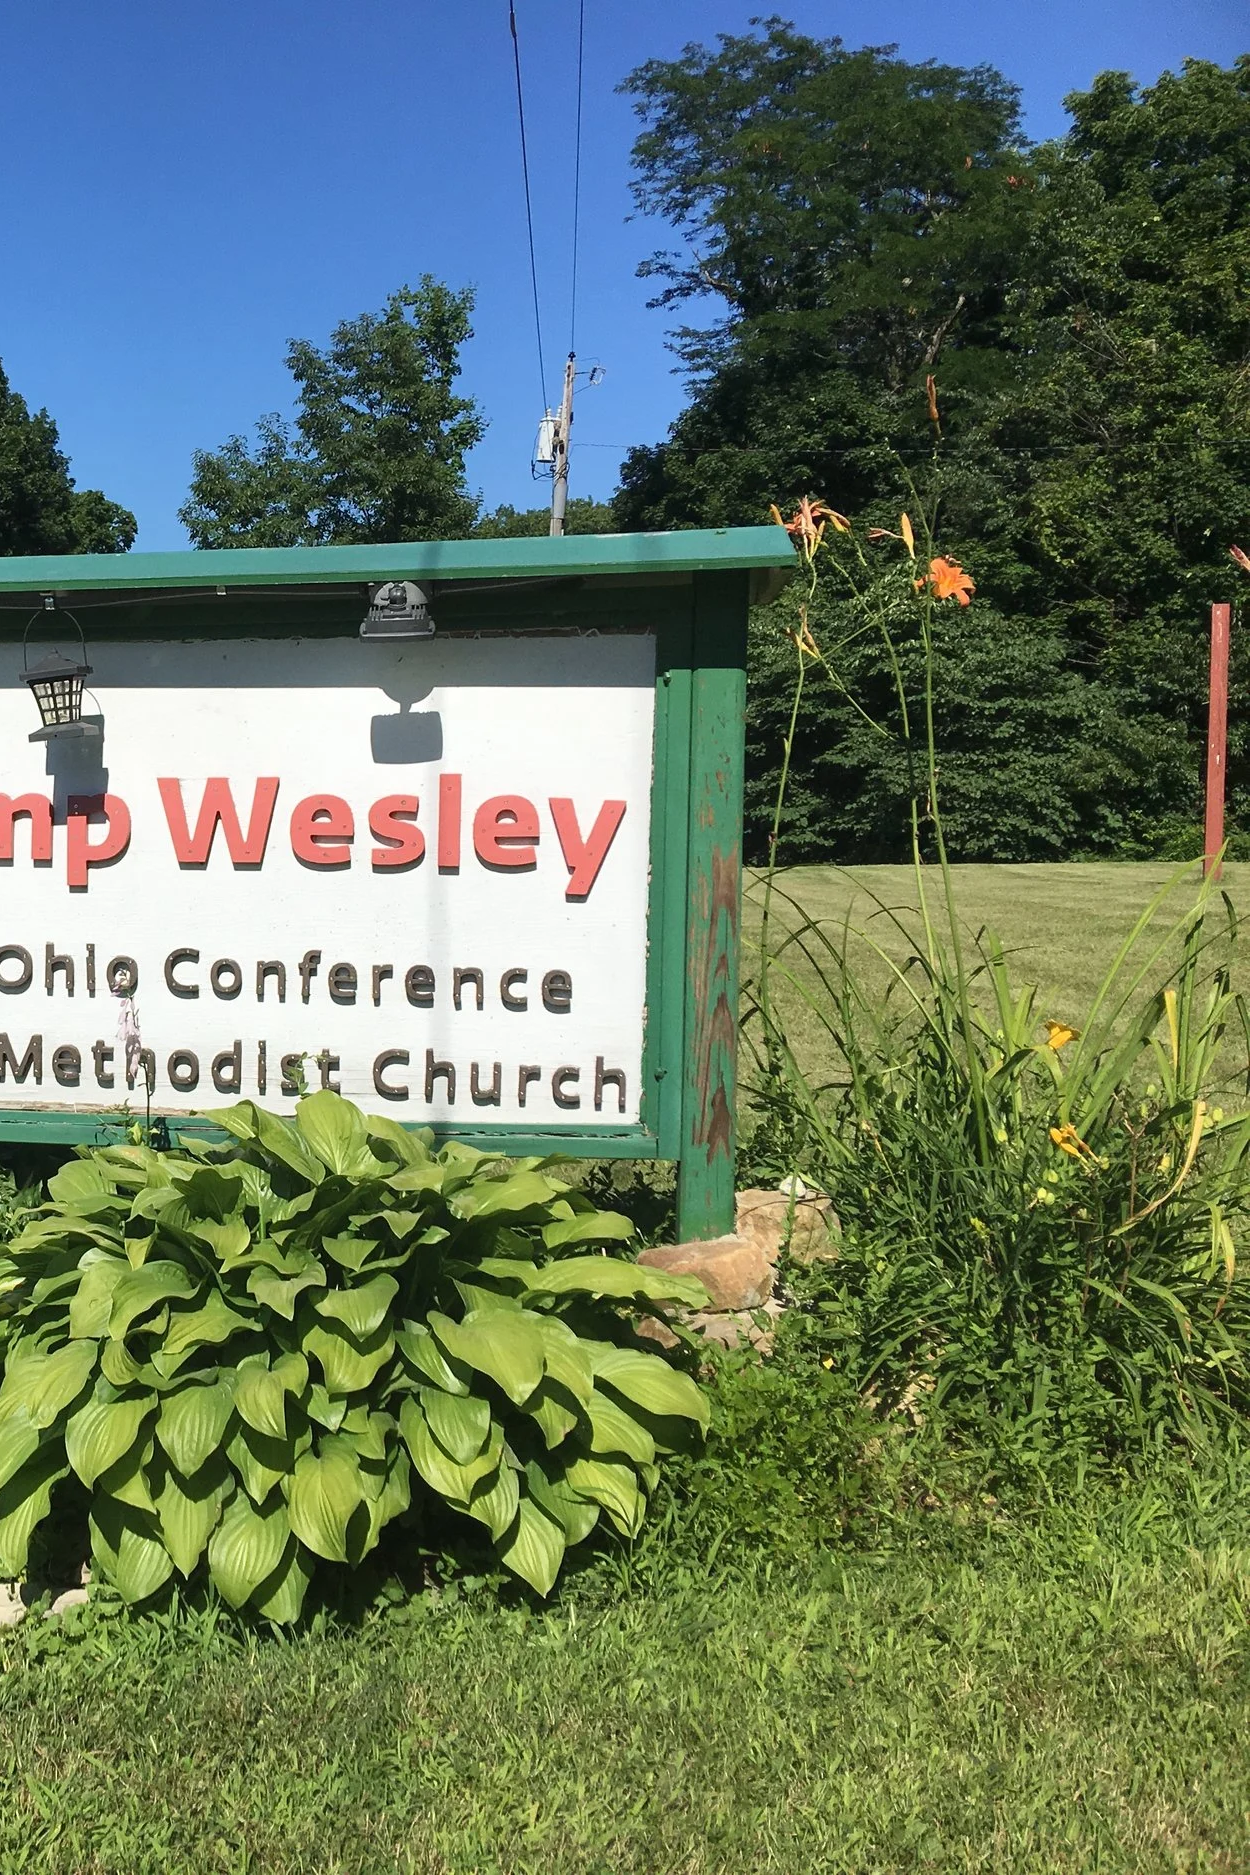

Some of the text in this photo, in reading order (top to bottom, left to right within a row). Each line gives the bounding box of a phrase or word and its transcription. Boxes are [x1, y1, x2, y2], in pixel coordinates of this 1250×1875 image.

[156, 773, 627, 898] Wesley
[163, 947, 573, 1012] Conference
[372, 1047, 627, 1112] Church
